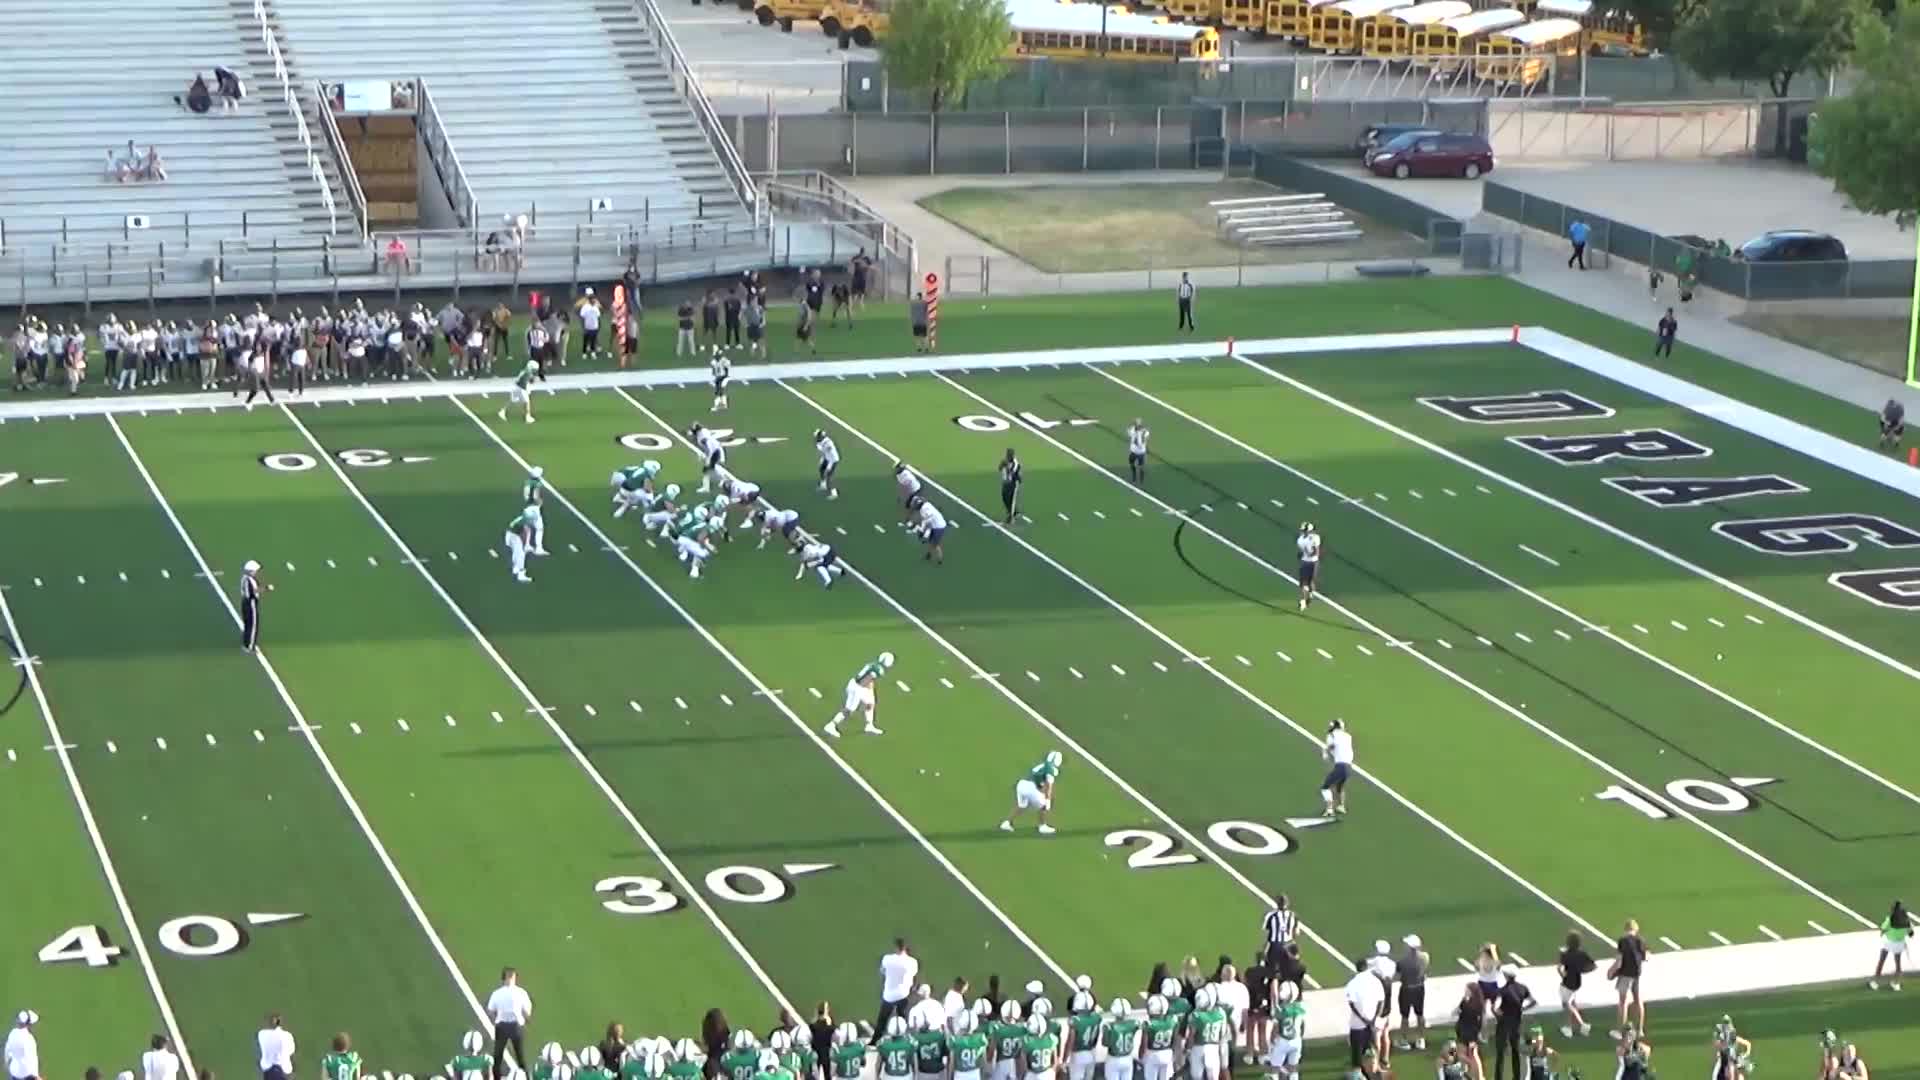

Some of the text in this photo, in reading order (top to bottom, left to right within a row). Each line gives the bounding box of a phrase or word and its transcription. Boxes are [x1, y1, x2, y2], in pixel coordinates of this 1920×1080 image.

[1594, 778, 1750, 819] 10
[1103, 821, 1289, 869] 20
[595, 865, 786, 915] 30
[38, 915, 240, 966] 40
[888, 1050, 906, 1070] 45
